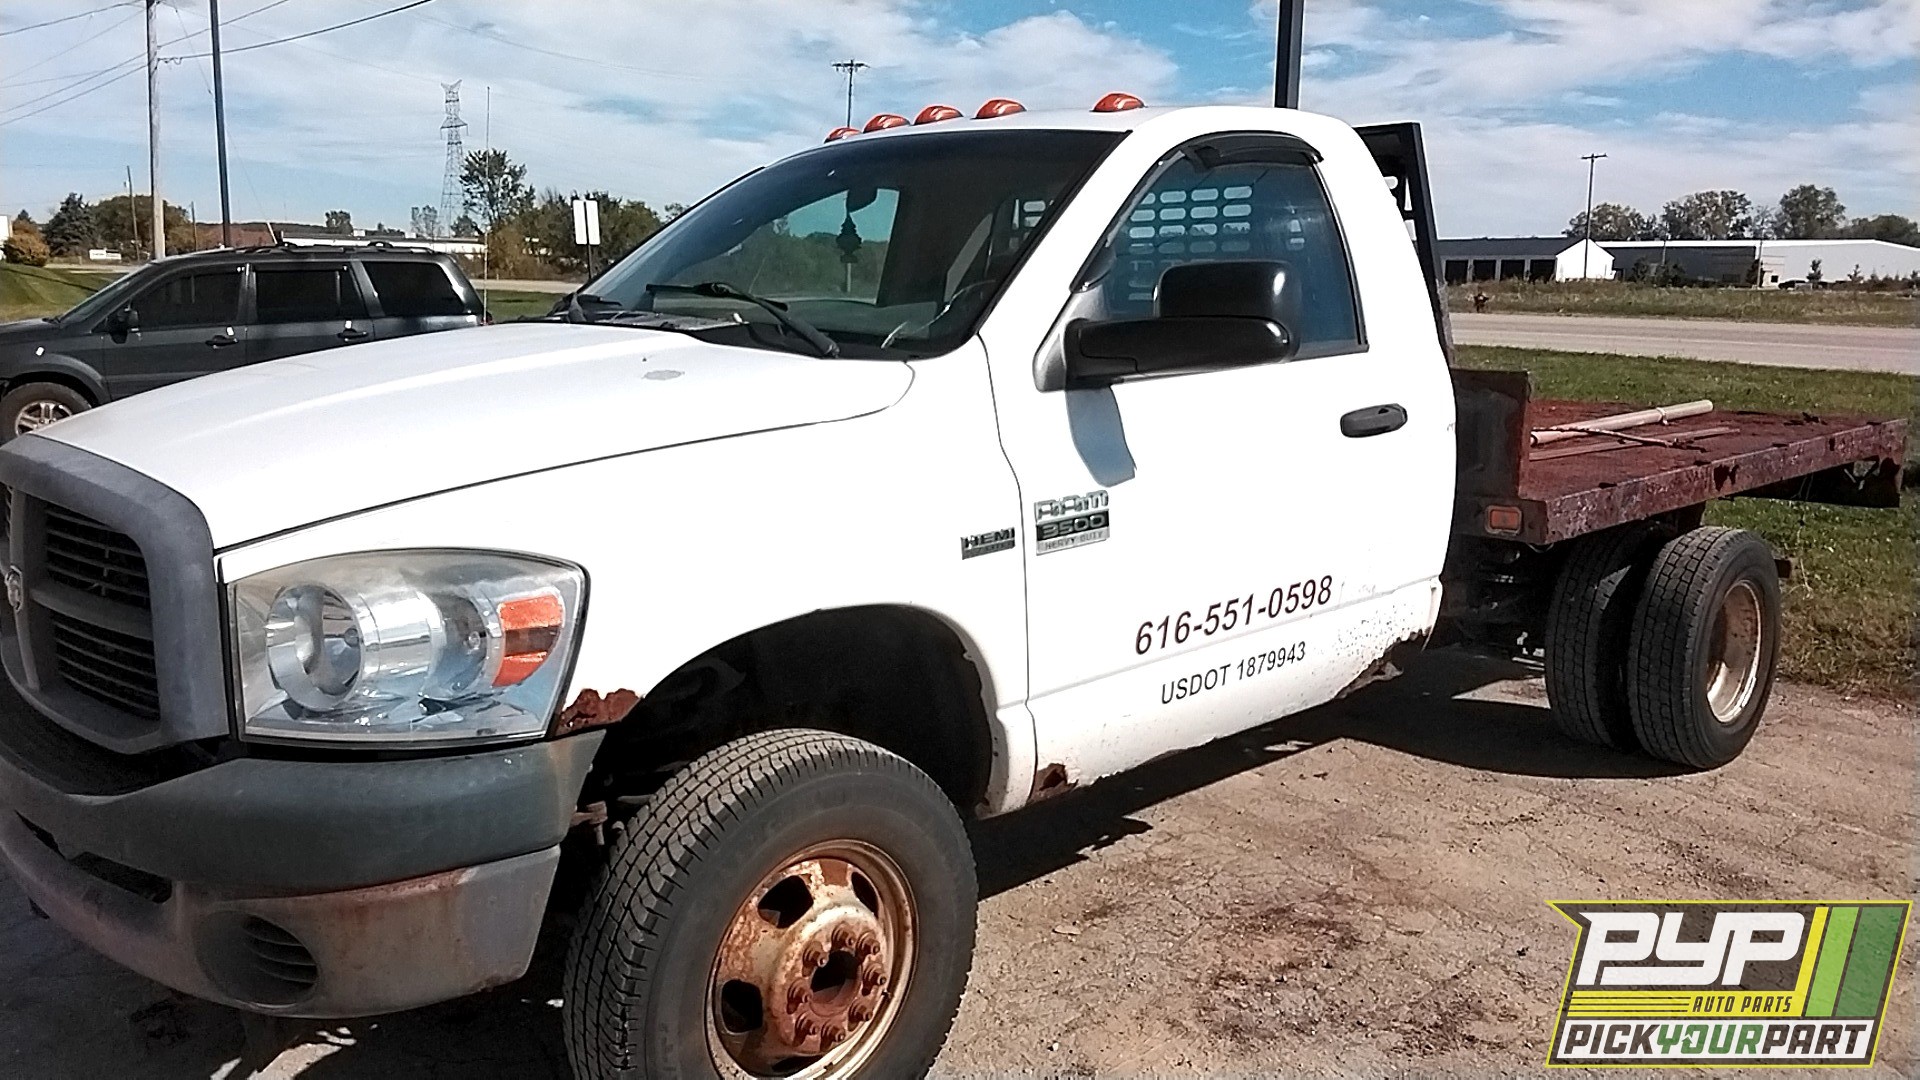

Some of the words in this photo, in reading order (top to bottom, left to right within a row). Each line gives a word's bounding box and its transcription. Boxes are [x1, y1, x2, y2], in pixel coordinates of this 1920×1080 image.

[961, 527, 1015, 549] HEMI
[1042, 514, 1105, 539] 3500
[1045, 535, 1077, 550] HEAVY
[1135, 575, 1332, 655] 616-551-0598
[1161, 664, 1231, 705] USDOT
[1236, 641, 1306, 680] 1879943
